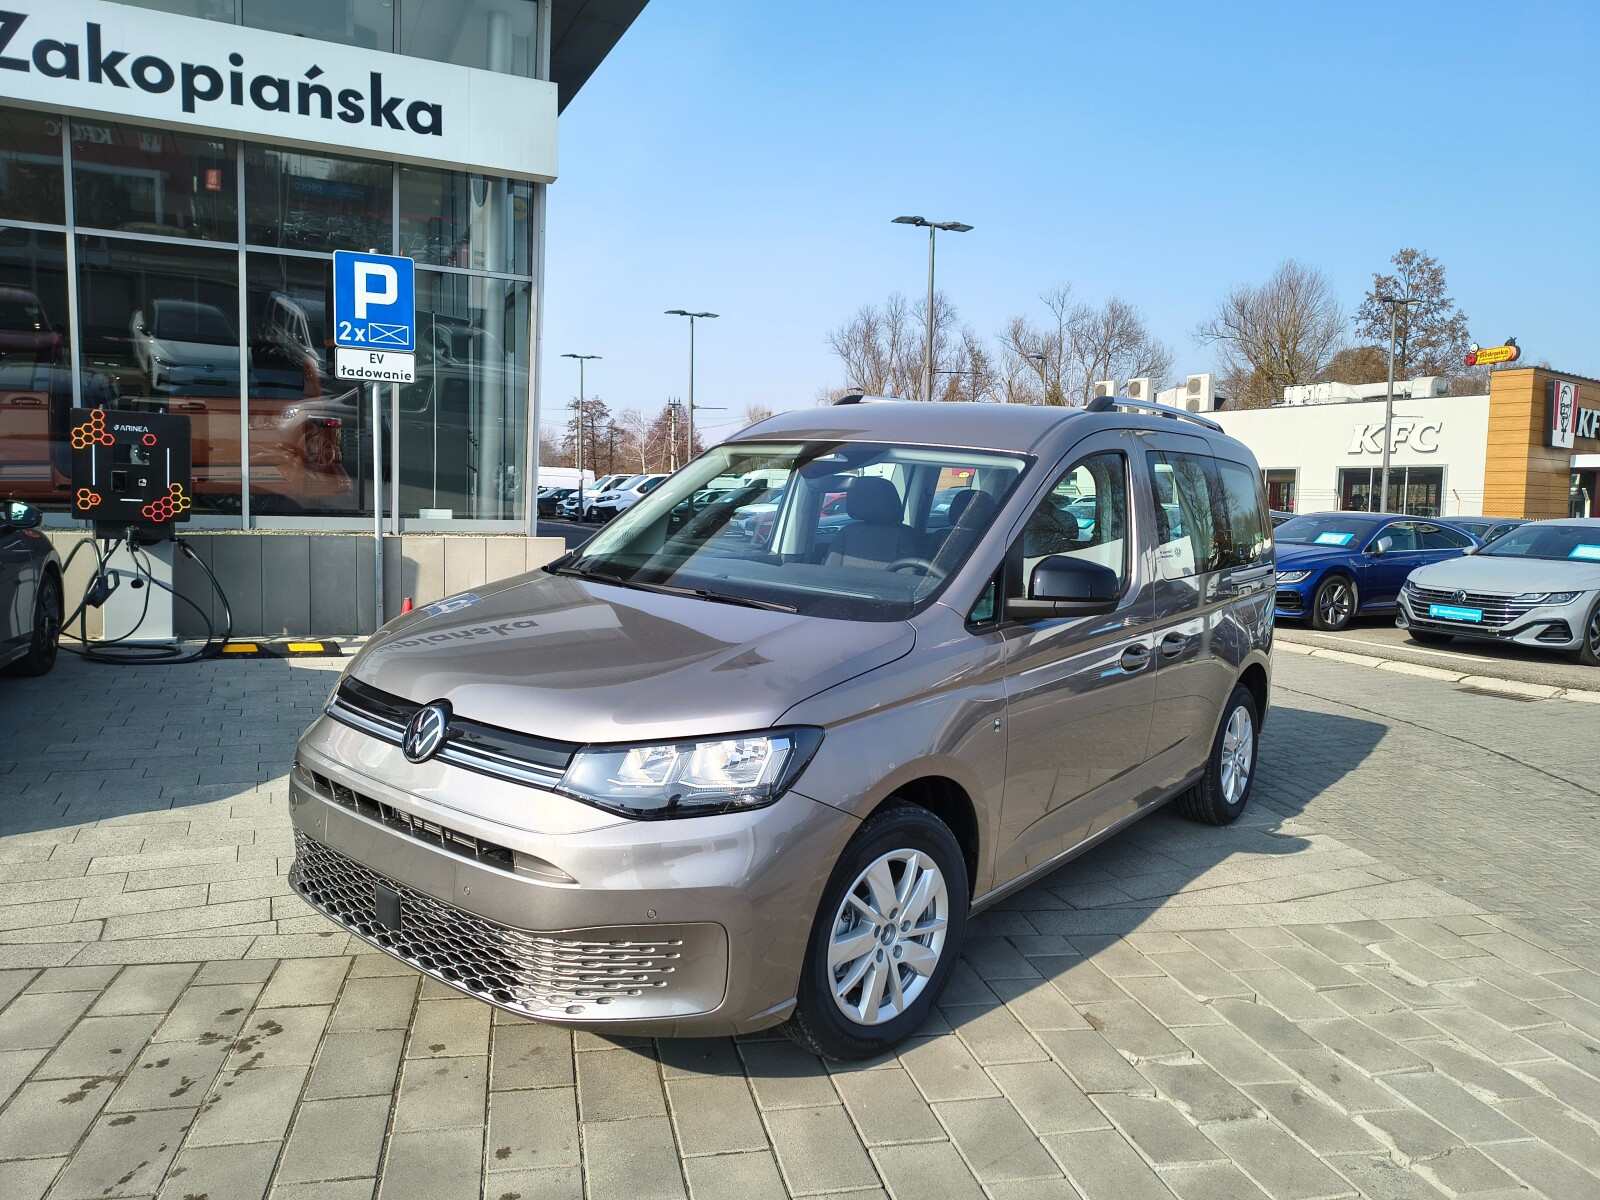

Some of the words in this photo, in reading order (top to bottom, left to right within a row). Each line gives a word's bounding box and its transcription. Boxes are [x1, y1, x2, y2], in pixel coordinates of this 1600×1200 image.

[0, 10, 443, 136] Zakopiańska
[354, 261, 398, 320] P
[339, 321, 366, 342] 2x
[369, 353, 384, 364] EV
[341, 365, 412, 381] ładowanie
[120, 424, 149, 433] ARINEA
[1346, 422, 1442, 455] KFC
